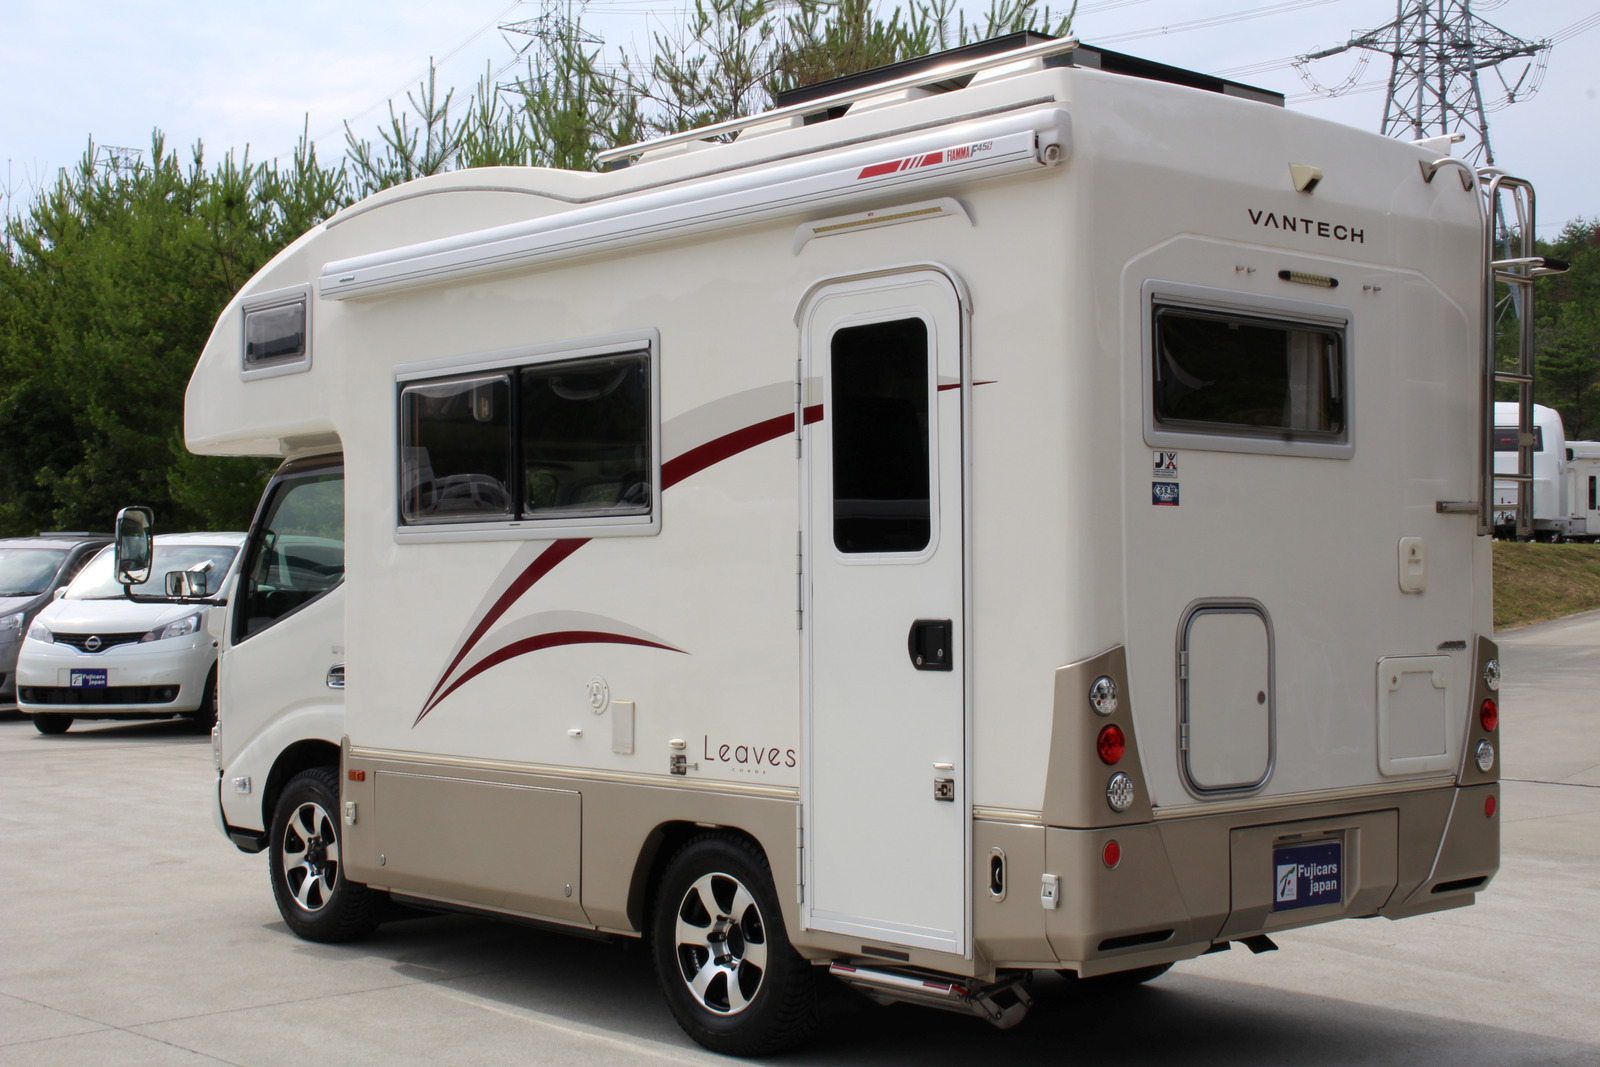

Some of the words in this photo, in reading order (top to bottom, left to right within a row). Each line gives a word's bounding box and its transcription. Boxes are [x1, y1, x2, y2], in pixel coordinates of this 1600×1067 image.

[947, 146, 970, 162] FIAMMA
[1248, 208, 1364, 243] VANTECH
[704, 734, 797, 768] Leaves
[1297, 863, 1338, 879] Fujicars
[1309, 879, 1337, 896] japan
